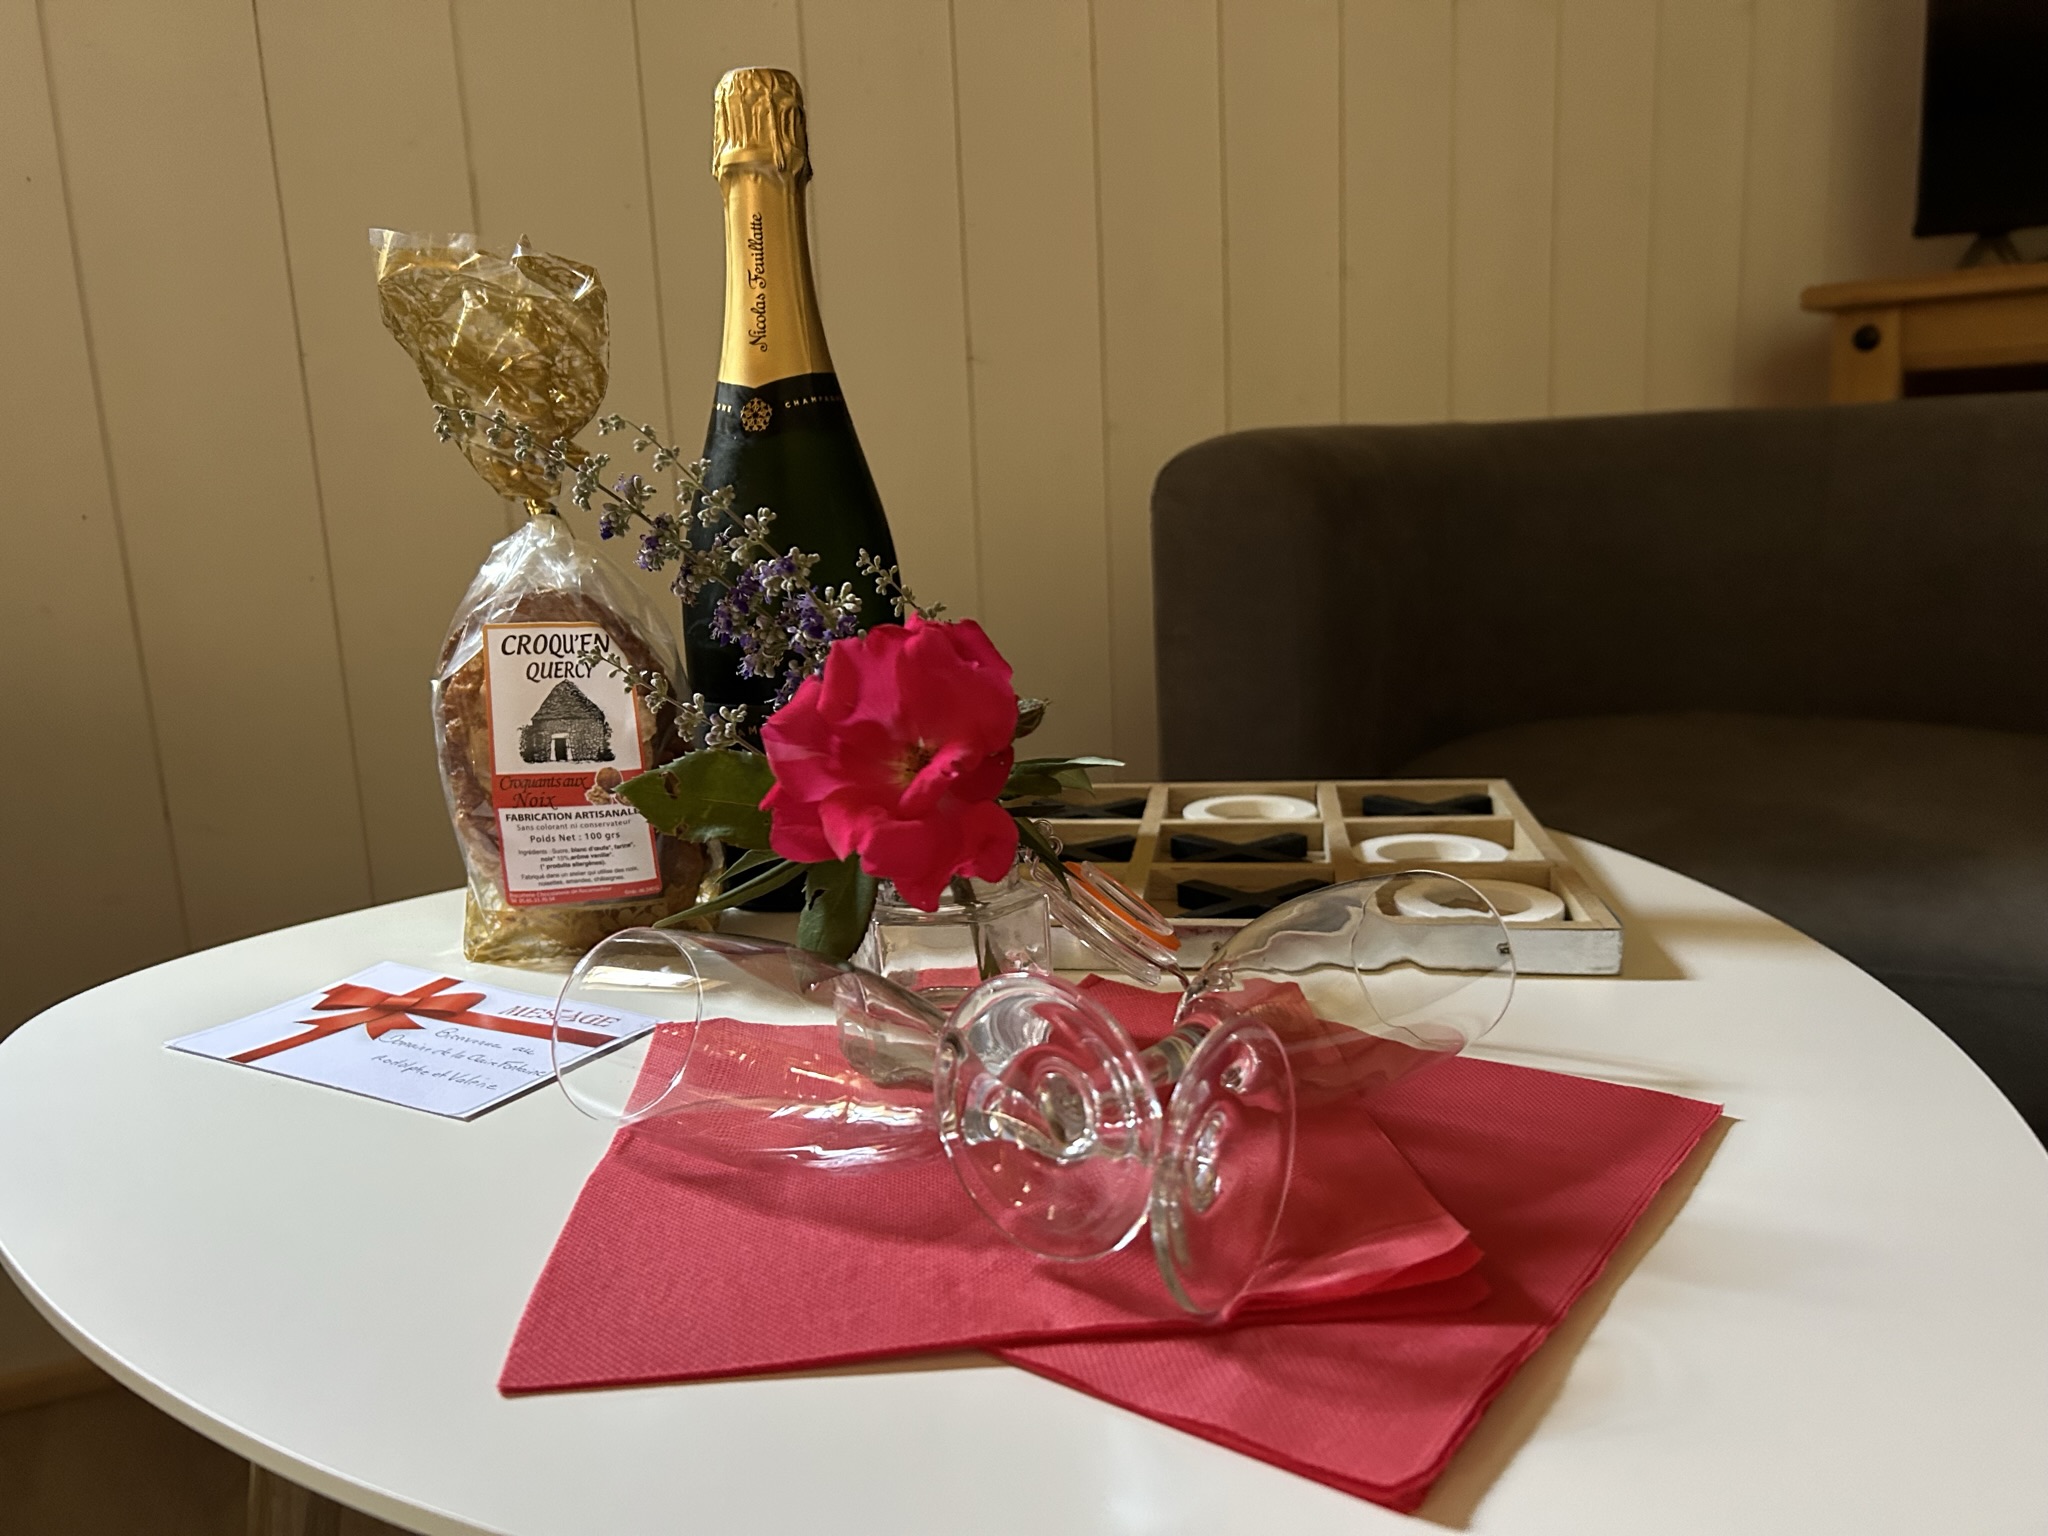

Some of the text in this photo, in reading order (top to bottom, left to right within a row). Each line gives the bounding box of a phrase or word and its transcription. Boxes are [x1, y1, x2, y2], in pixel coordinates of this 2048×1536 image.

[747, 211, 768, 352] Nicolas Feuillatte
[501, 633, 610, 658] CROQU'EN
[526, 660, 593, 683] QUERCY
[500, 775, 592, 793] Croquants aux
[512, 791, 559, 811] Noix
[505, 811, 573, 822] FABRICATION
[516, 819, 632, 832] Sans colorant ni conservateur
[530, 834, 556, 843] Poids
[558, 833, 576, 842] Net
[585, 832, 603, 841] 100
[604, 831, 621, 841] grs
